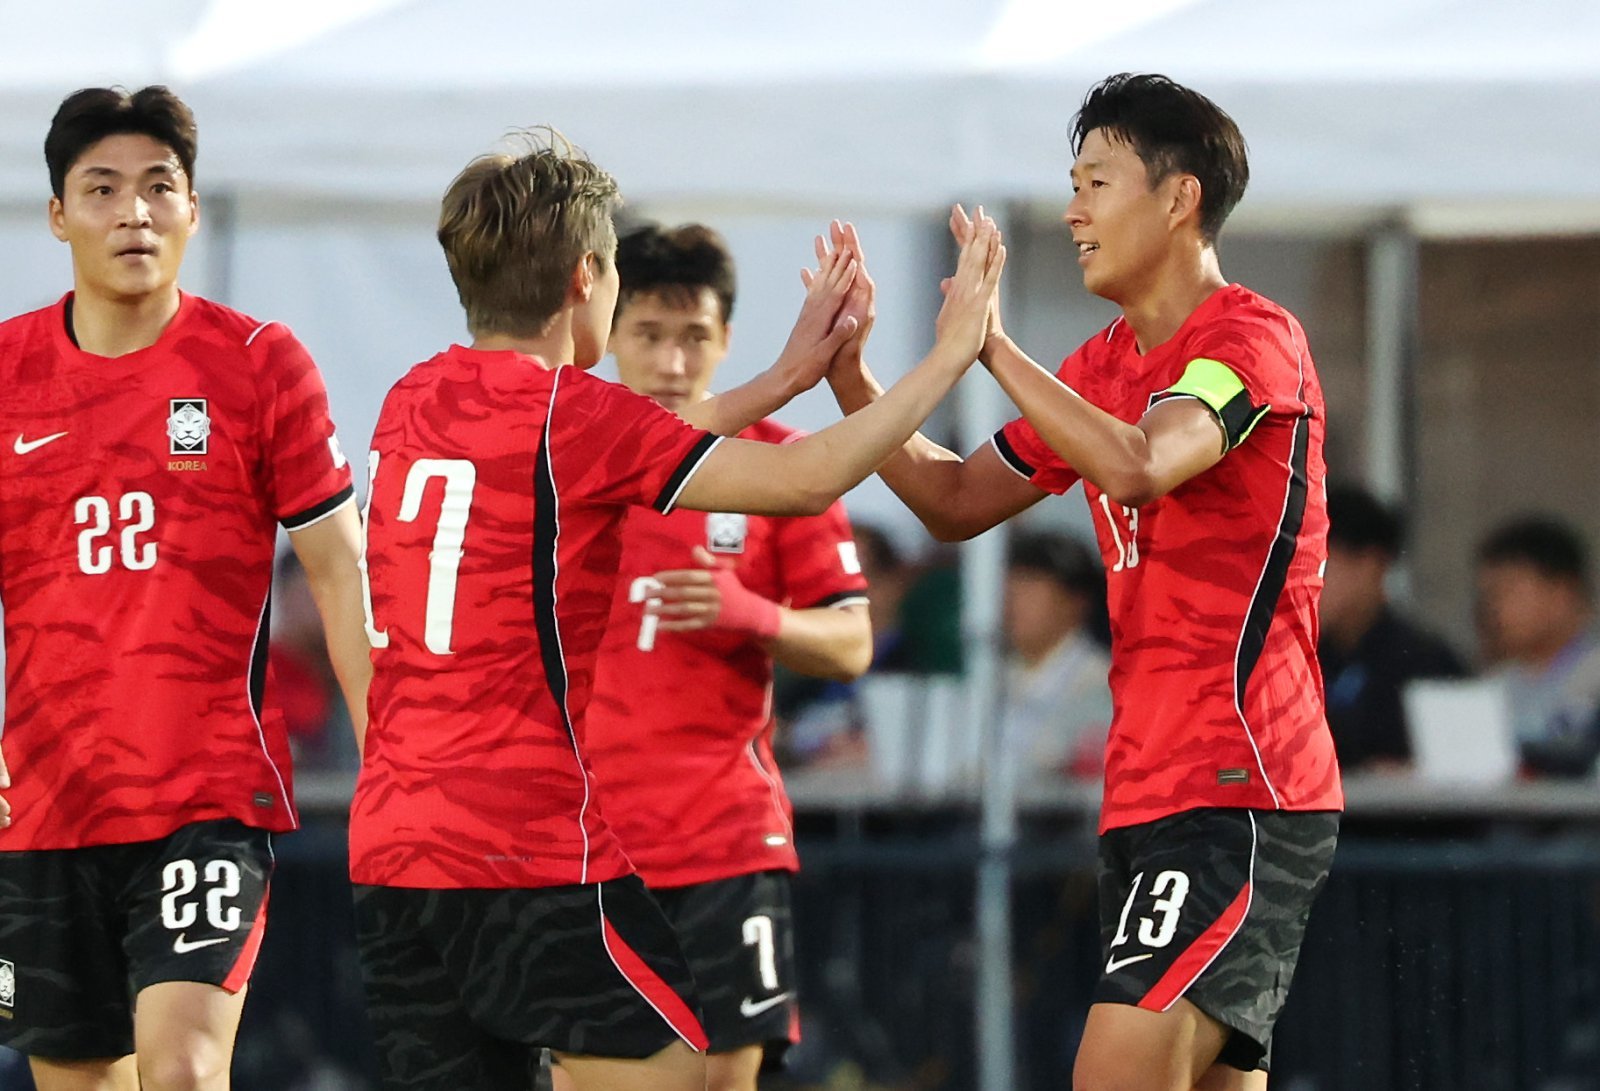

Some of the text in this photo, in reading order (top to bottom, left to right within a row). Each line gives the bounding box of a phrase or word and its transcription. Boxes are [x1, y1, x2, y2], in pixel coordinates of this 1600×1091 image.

[167, 460, 208, 472] KOREA
[74, 491, 159, 574] 22
[161, 859, 242, 931] 22
[1110, 870, 1190, 948] 13
[742, 915, 779, 989] 7
